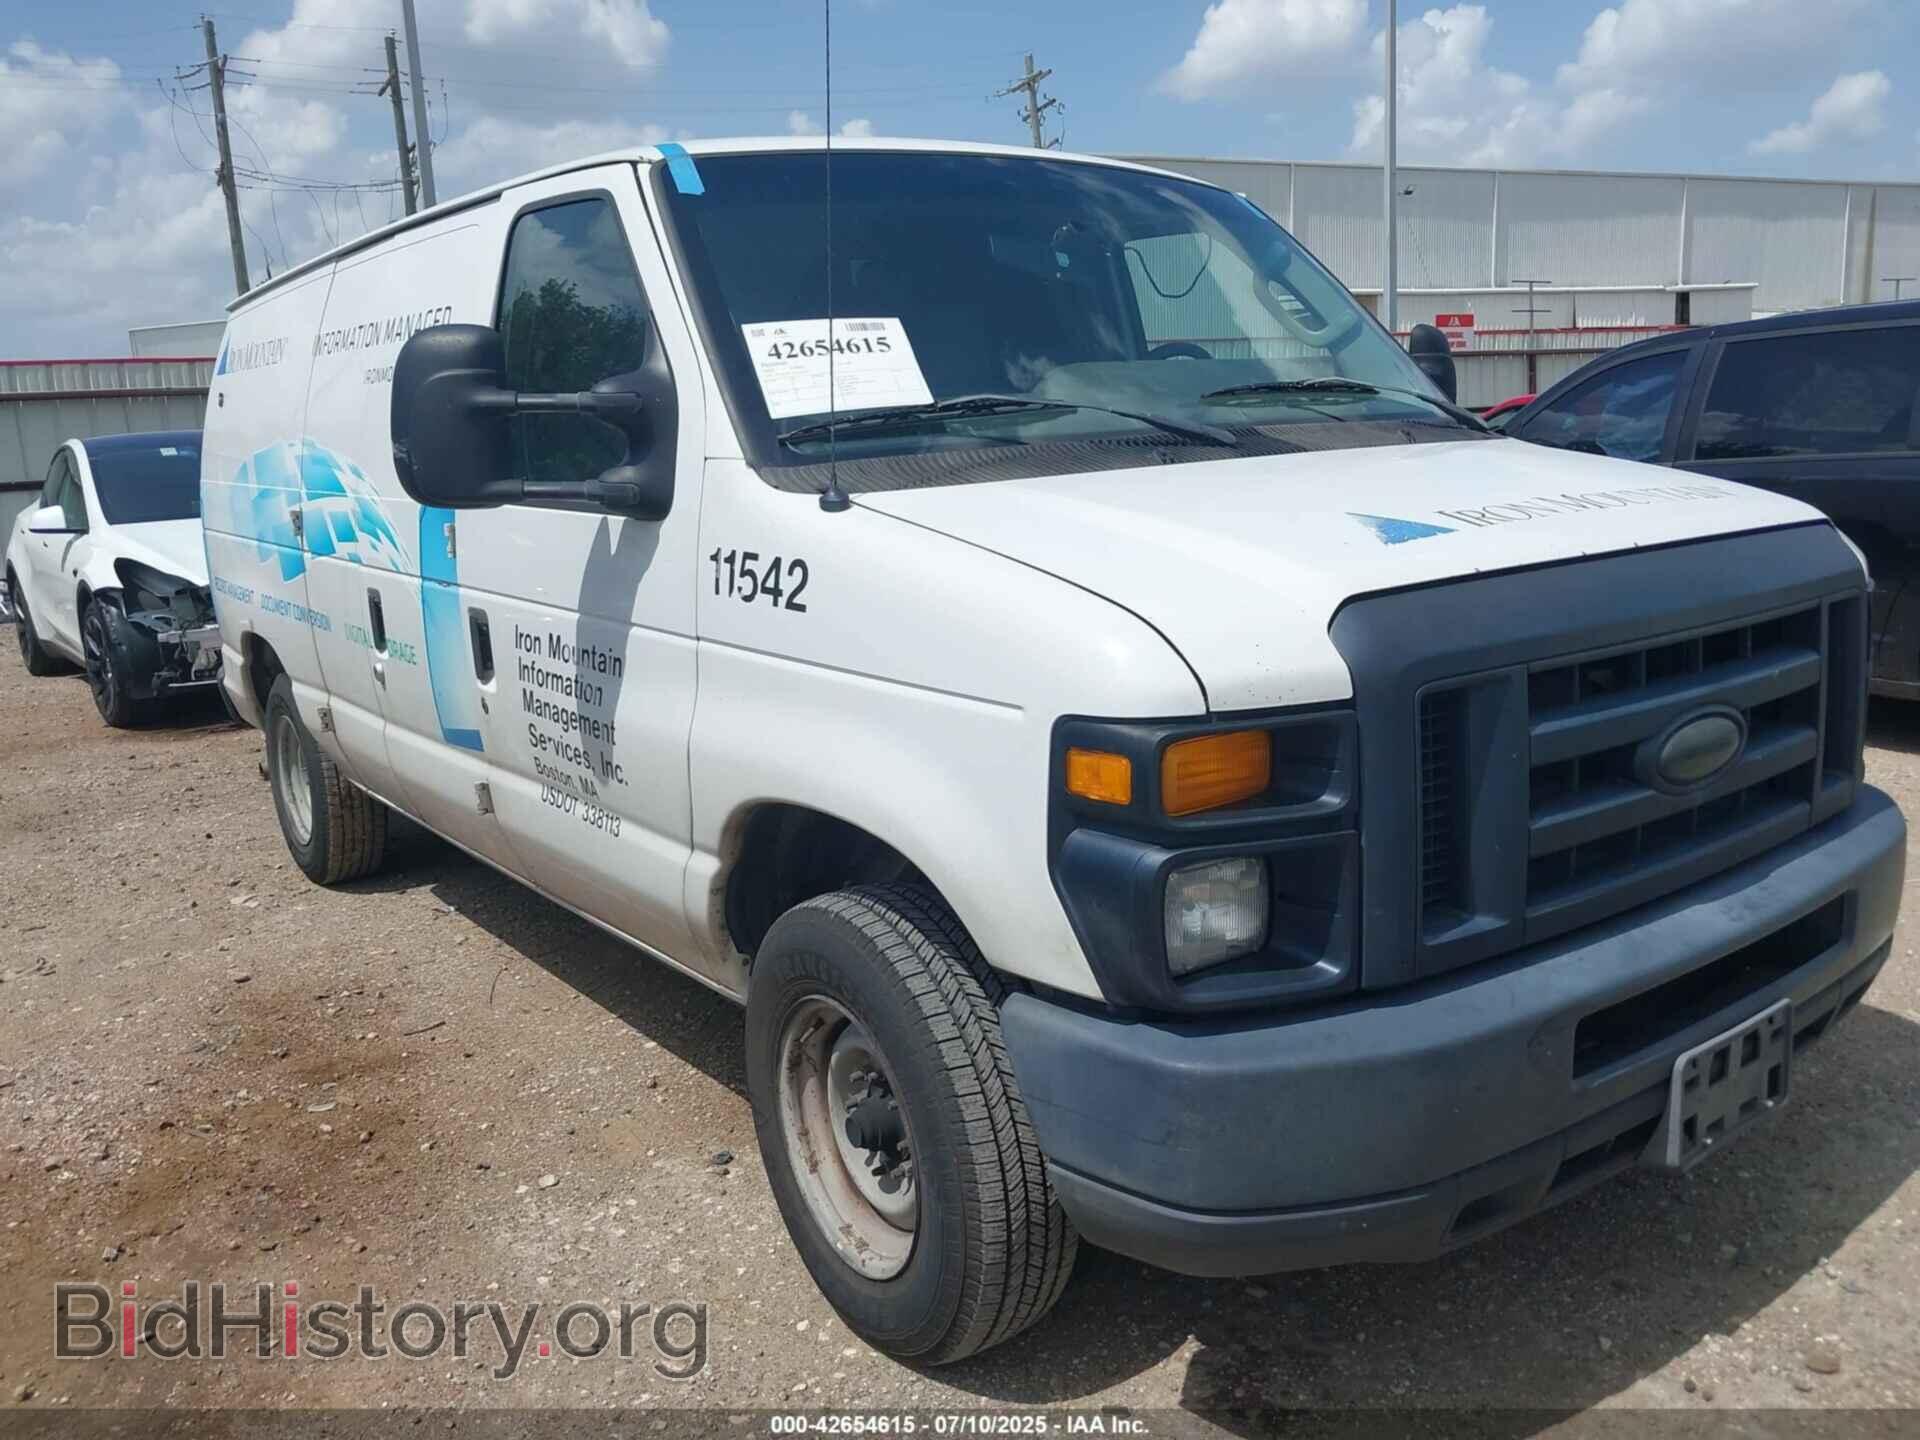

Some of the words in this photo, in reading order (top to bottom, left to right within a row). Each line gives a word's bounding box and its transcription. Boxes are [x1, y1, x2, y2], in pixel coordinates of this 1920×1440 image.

[312, 321, 382, 356] INFORMATION
[768, 336, 892, 360] 42654615
[1433, 500, 1564, 527] IRON
[709, 547, 809, 613] 11542
[514, 623, 542, 655] Iron
[548, 632, 622, 678] Mountain
[518, 656, 603, 708] Information
[522, 687, 617, 746] Management
[528, 722, 596, 777] Services,
[600, 750, 630, 787] Inc.
[541, 783, 579, 817] USDOT
[582, 801, 622, 838] 338113
[578, 775, 600, 800] MA
